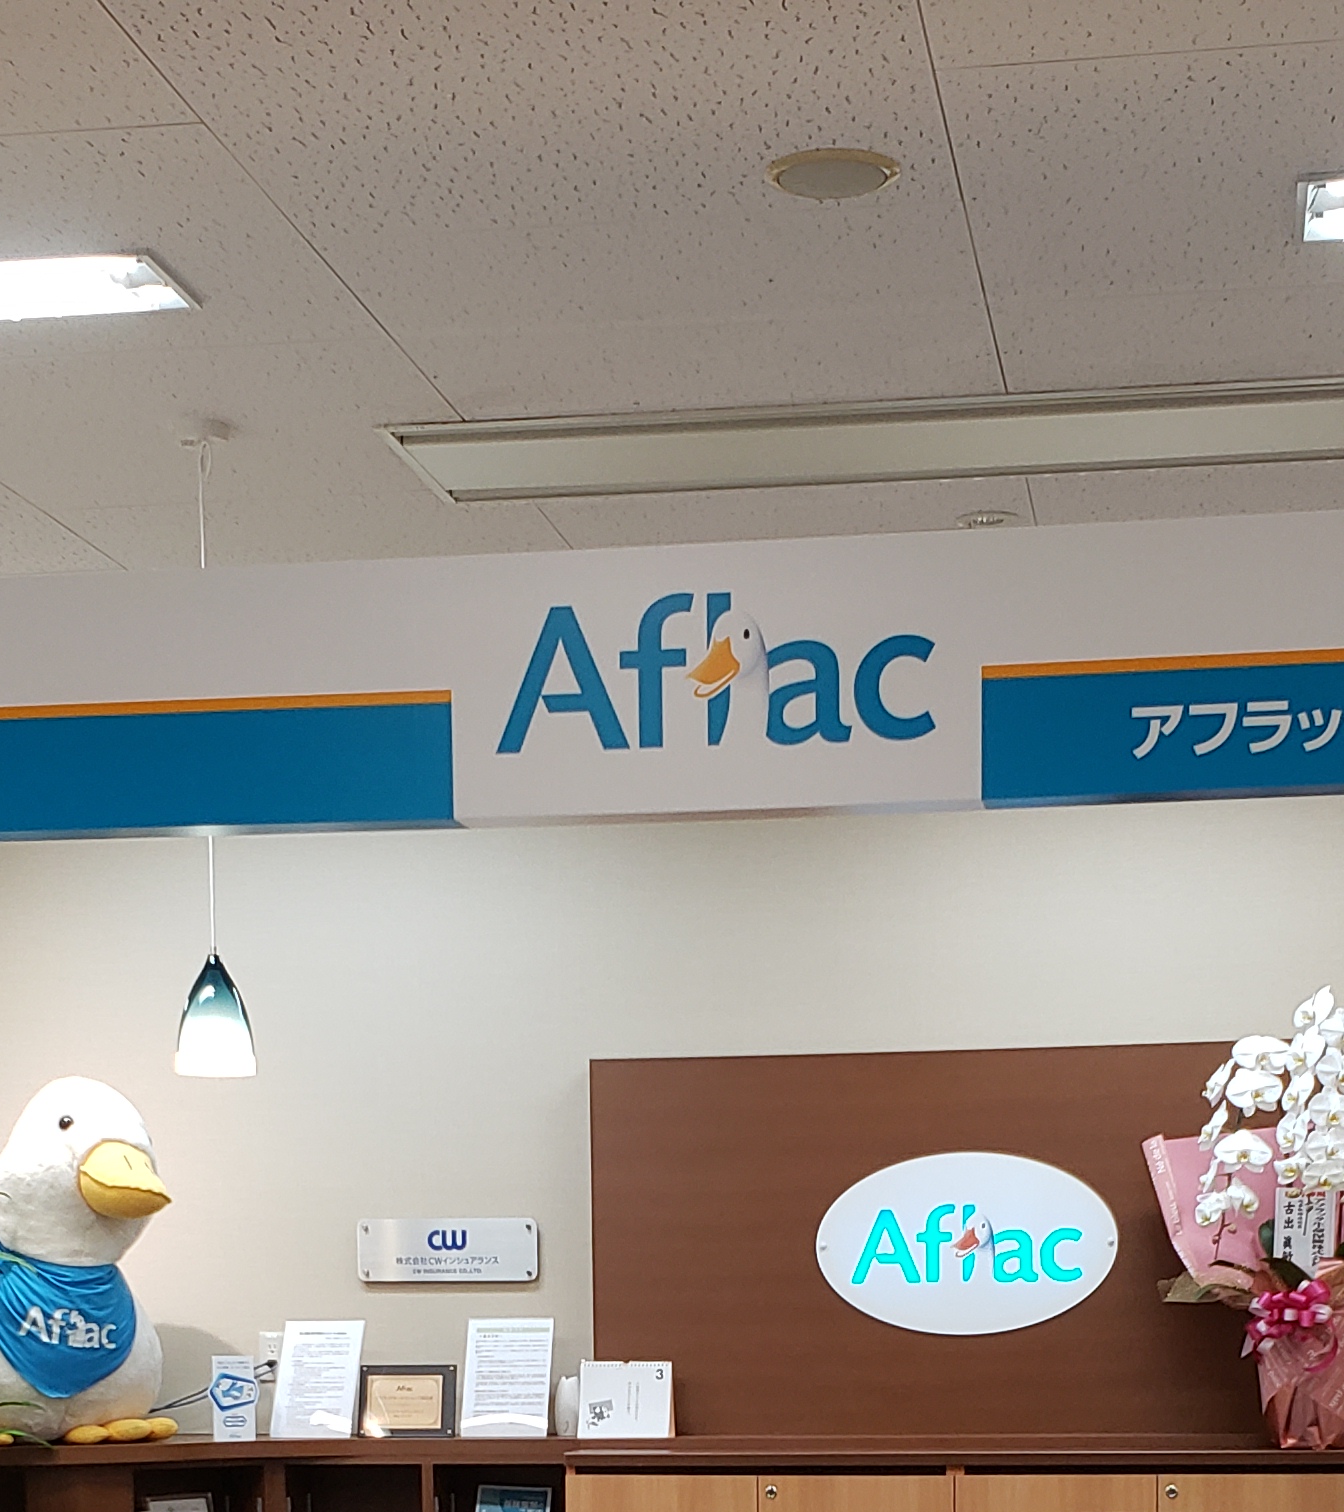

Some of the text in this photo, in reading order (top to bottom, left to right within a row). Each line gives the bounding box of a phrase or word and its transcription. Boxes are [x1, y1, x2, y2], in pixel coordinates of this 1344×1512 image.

[496, 592, 936, 754] Aflac
[427, 1230, 467, 1251] CW
[852, 1203, 1083, 1284] Aflac
[19, 1306, 117, 1349] Aflac
[655, 1369, 664, 1380] 3
